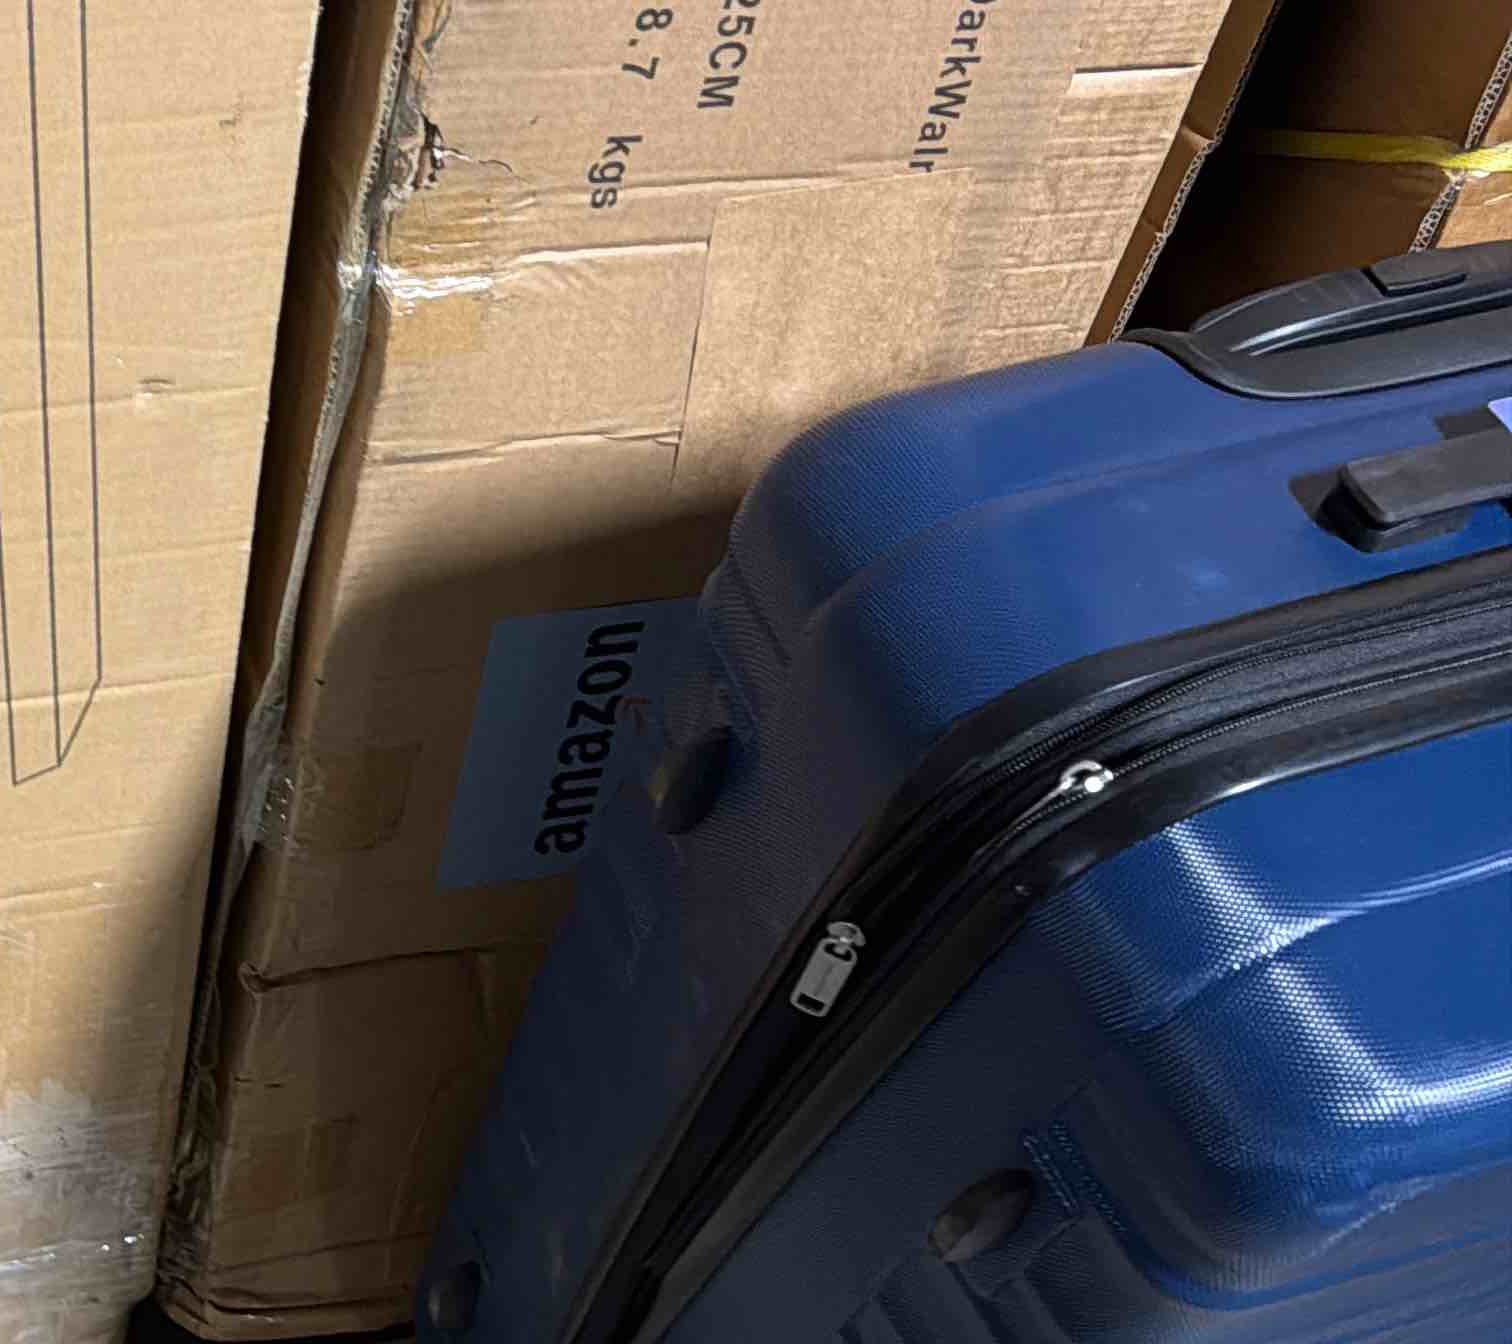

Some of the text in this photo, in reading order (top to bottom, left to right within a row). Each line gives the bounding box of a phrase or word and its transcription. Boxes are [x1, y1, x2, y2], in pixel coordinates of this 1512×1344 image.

[621, 8, 674, 80] 8.7
[587, 135, 643, 209] kgs
[533, 619, 646, 855] amazon
